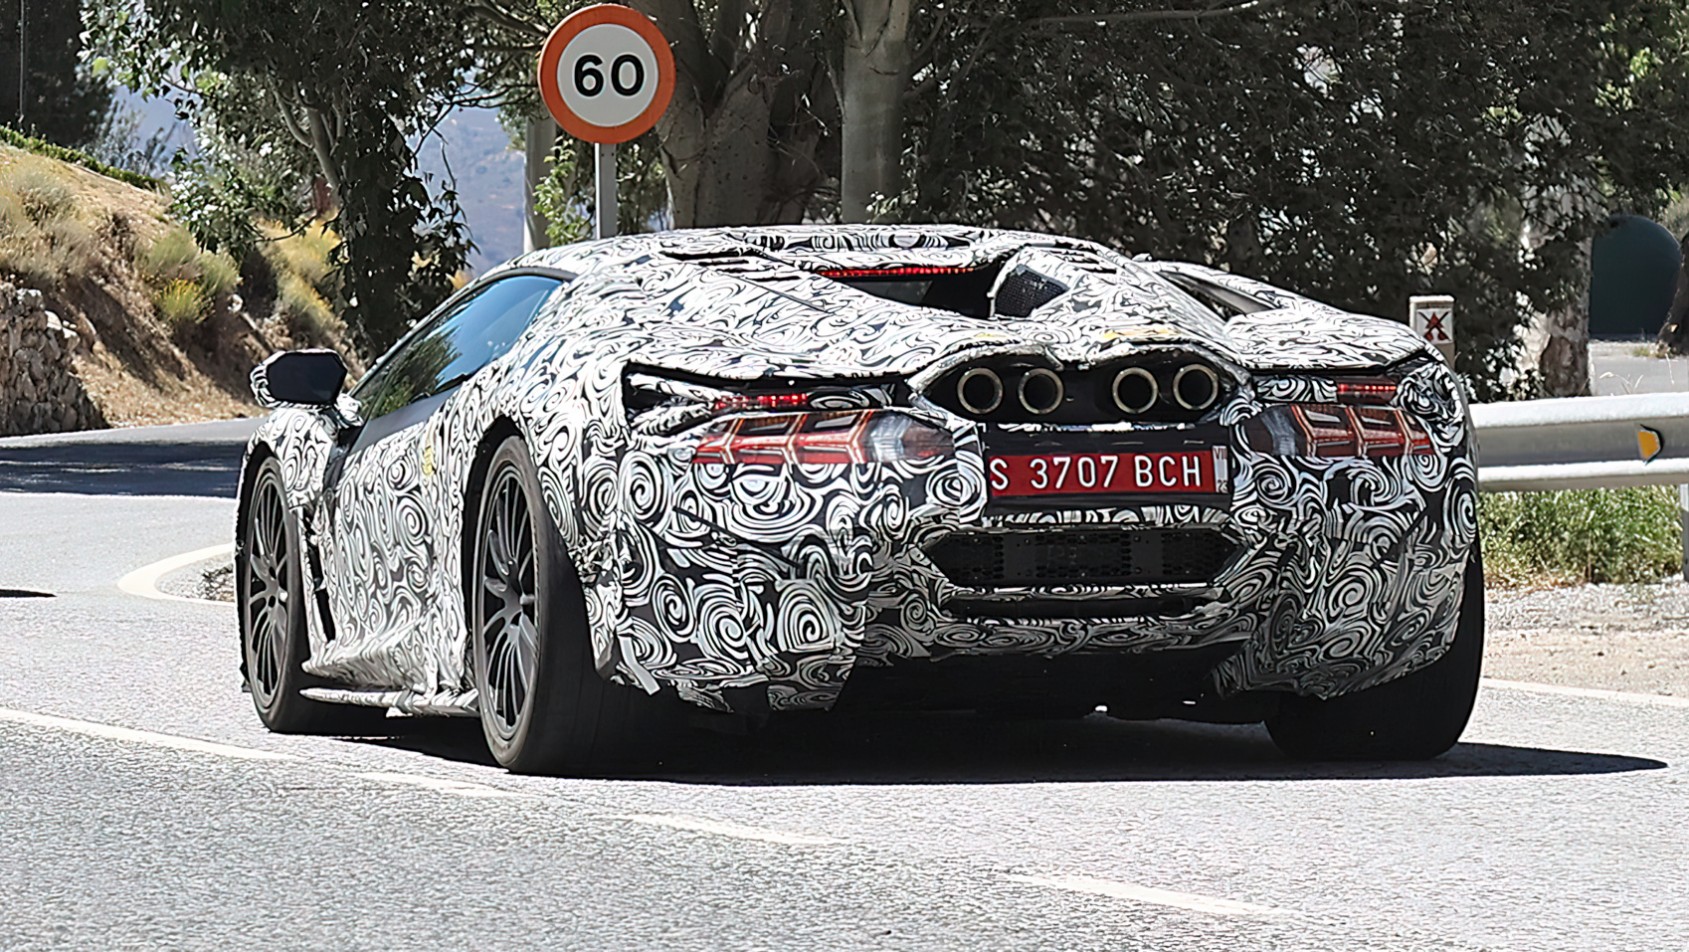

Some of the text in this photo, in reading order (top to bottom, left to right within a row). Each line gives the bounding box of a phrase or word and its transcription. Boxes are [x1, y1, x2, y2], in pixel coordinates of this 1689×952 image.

[574, 54, 645, 97] 60
[989, 455, 1201, 490] S 3707 BCH
